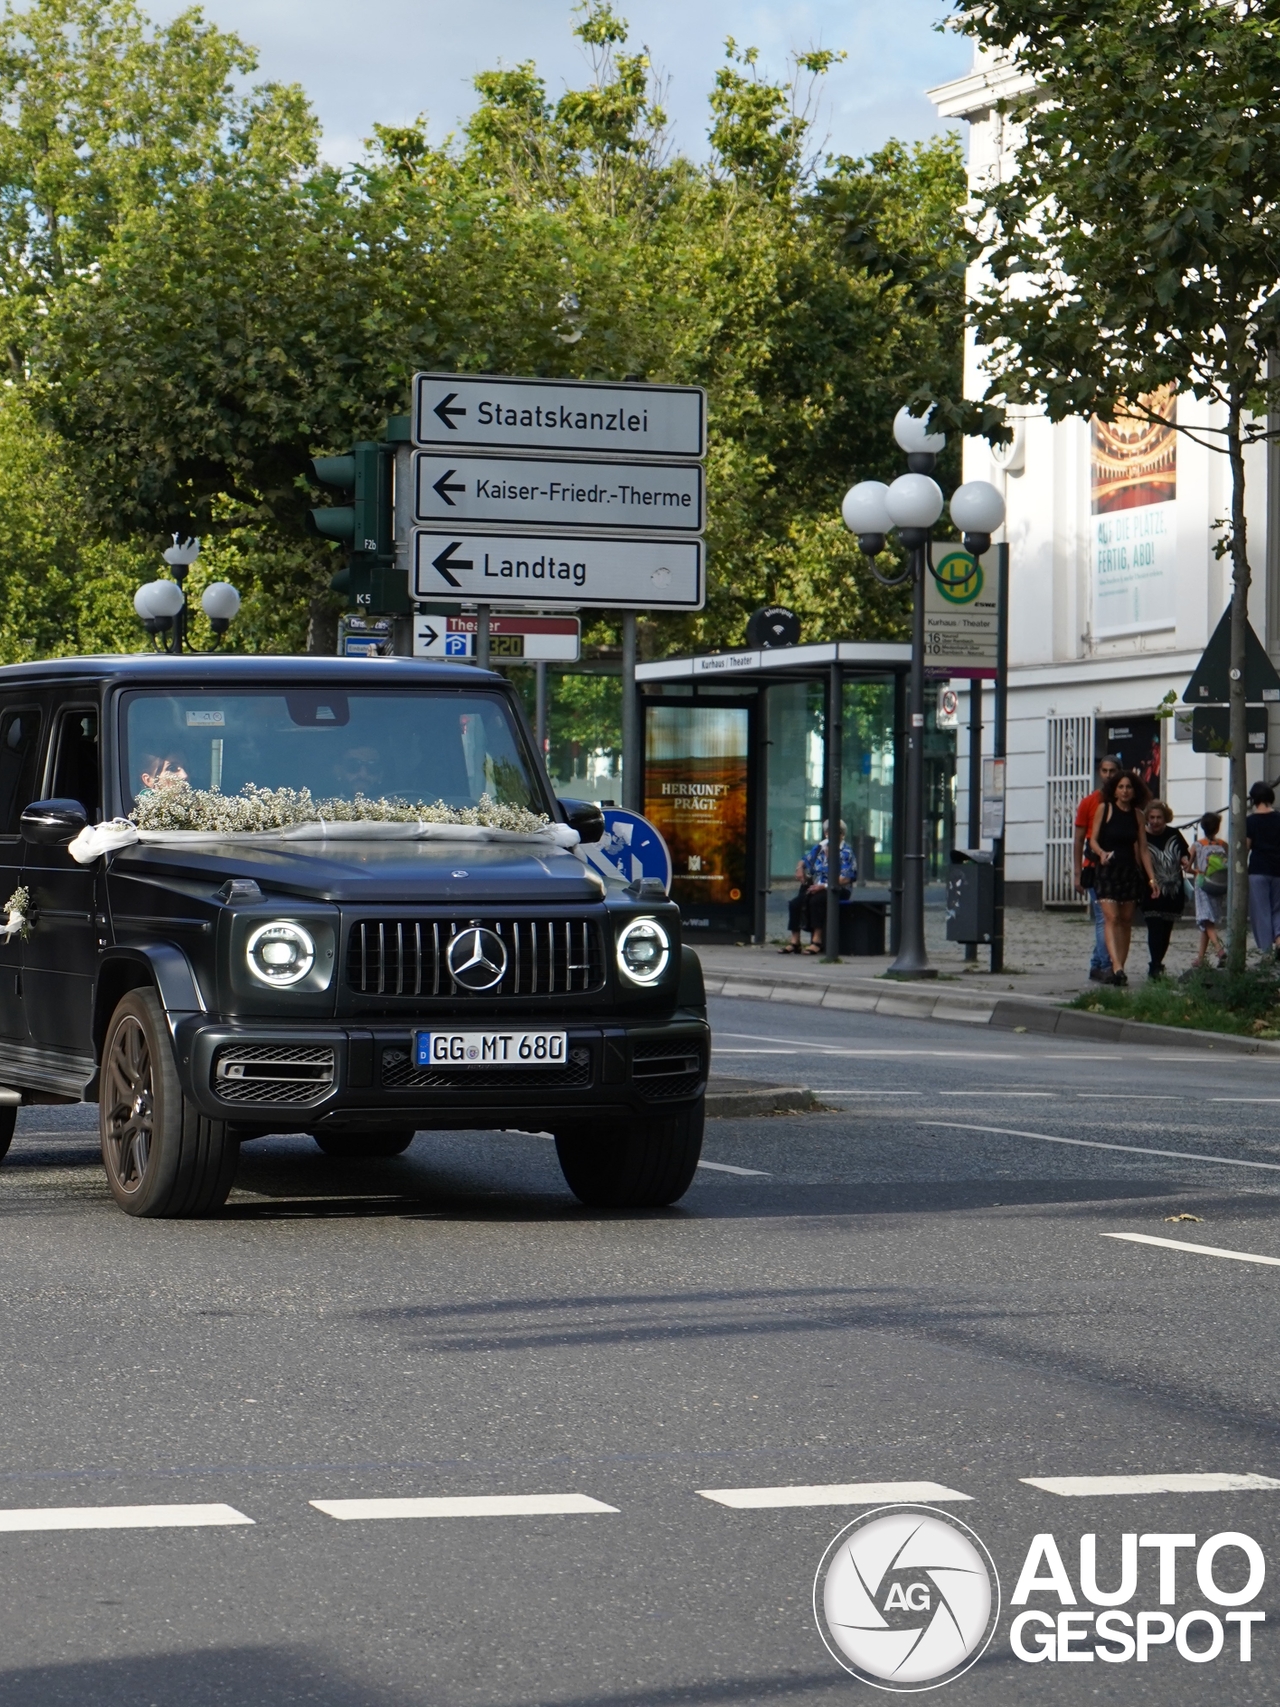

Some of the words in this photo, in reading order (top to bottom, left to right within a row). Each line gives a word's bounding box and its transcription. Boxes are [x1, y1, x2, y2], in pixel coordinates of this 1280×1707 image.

[477, 401, 649, 433] Staatskanzlei
[476, 479, 692, 508] Kaiser-Friedr.-Therme
[1116, 517, 1129, 541] DIE
[1133, 510, 1167, 538] PLÄTZE,
[1098, 547, 1130, 573] FERTIG,
[1133, 541, 1155, 567] ABO!
[484, 553, 587, 586] Landtag
[764, 608, 794, 619] bluespot
[449, 618, 501, 631] Theaer
[963, 619, 991, 628] Theater
[928, 633, 941, 643] 16
[701, 659, 725, 669] Kurhaus
[730, 656, 753, 667] Theater
[661, 783, 731, 797] HERKUNFT
[673, 796, 718, 811] PRÄGT.
[689, 919, 710, 927] Wall
[433, 1036, 464, 1061] GG
[482, 1035, 513, 1061] MT
[518, 1035, 563, 1060] 680
